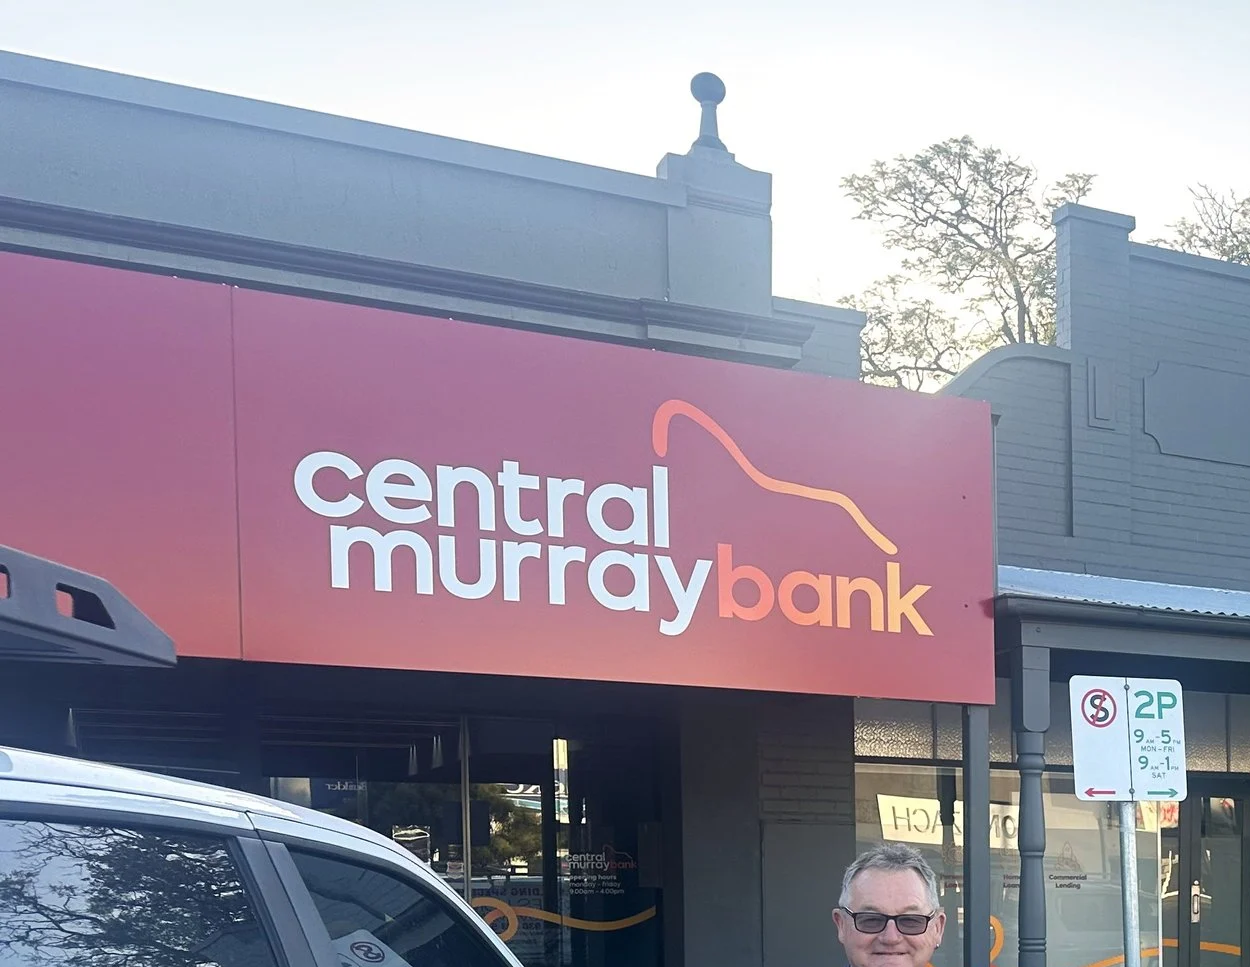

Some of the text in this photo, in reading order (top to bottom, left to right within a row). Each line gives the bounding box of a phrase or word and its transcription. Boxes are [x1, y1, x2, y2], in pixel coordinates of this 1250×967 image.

[293, 450, 670, 548] central
[1134, 690, 1177, 719] 2P
[565, 852, 605, 862] central
[569, 874, 597, 882] opening
[569, 881, 596, 889] monday
[1055, 882, 1080, 890] Lending
